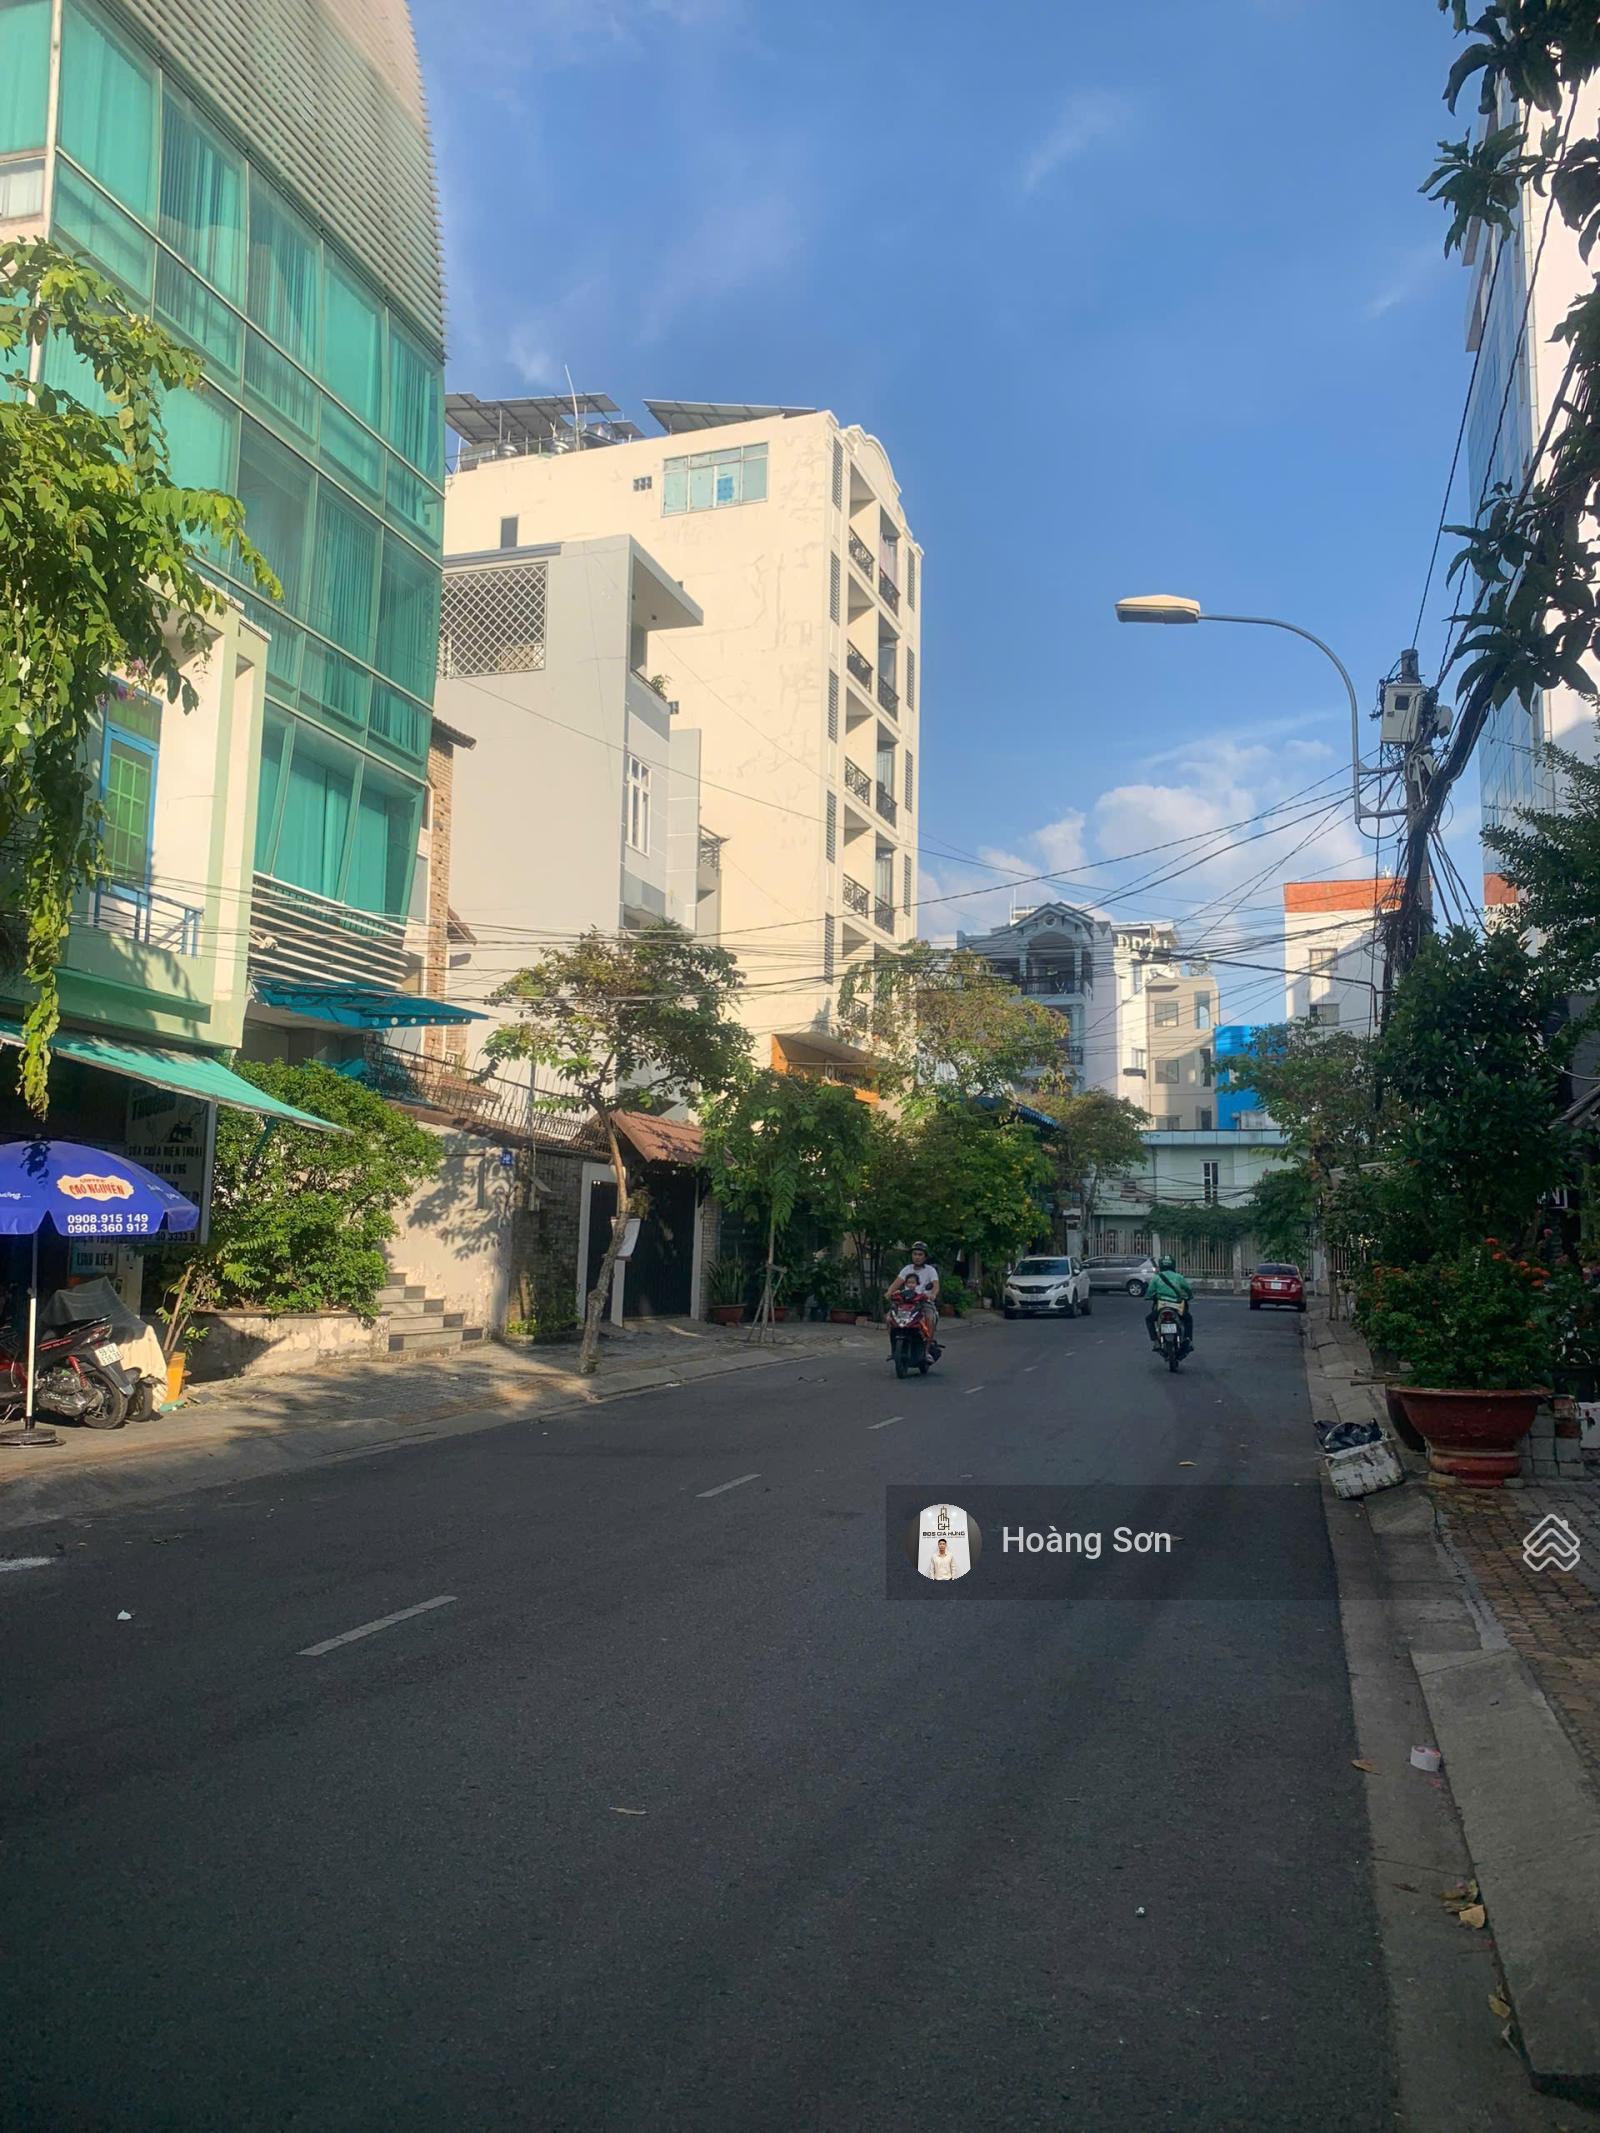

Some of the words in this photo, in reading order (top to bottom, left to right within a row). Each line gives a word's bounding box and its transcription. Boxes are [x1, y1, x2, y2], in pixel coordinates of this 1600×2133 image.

[69, 1184, 87, 1195] CAO
[67, 1214, 123, 1224] 0908.915
[127, 1213, 149, 1223] 149
[67, 1223, 123, 1233] 0908.360
[126, 1223, 148, 1233] 912
